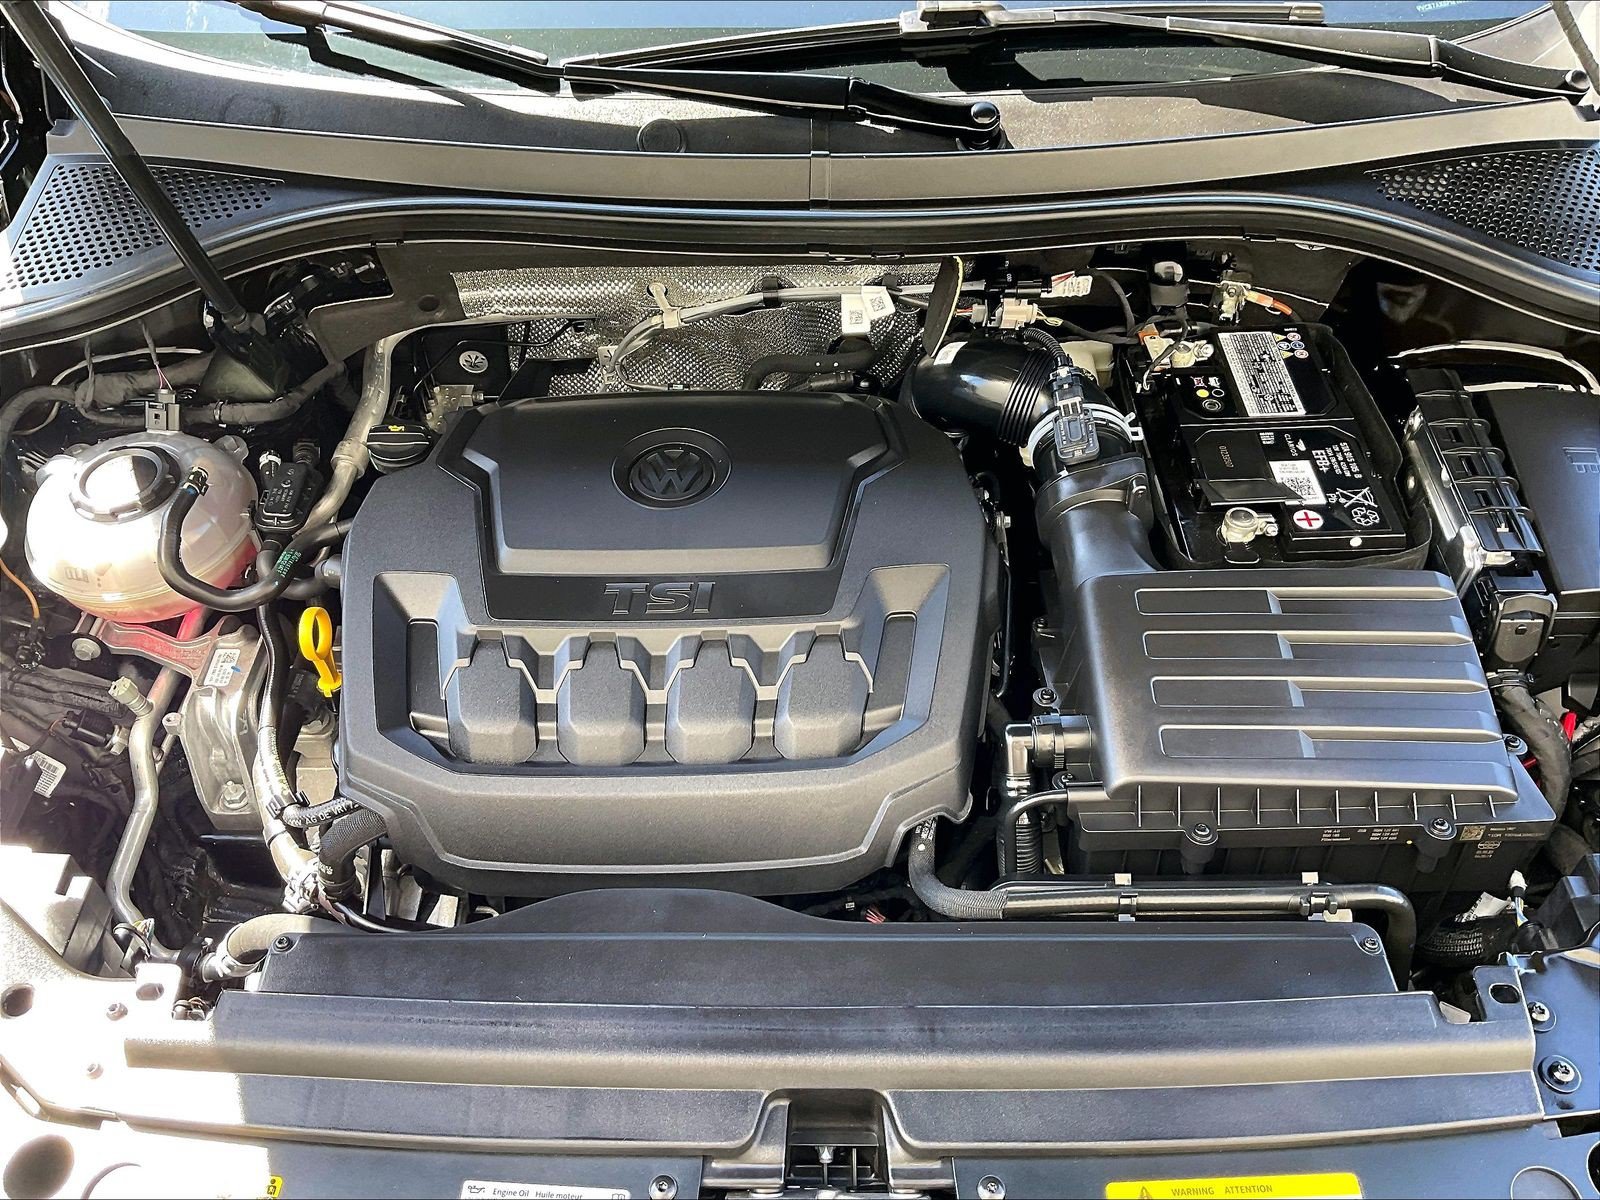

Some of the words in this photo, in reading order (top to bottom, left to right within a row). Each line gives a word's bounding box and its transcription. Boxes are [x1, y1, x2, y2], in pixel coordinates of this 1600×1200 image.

[1311, 449, 1331, 474] EFB+
[604, 582, 716, 616] TSI
[305, 815, 317, 825] AG
[493, 1188, 517, 1198] Engine
[518, 1189, 530, 1198] Oil
[535, 1190, 554, 1199] Huile
[1171, 1186, 1215, 1197] WARNING
[1224, 1184, 1273, 1195] ATTENTION
